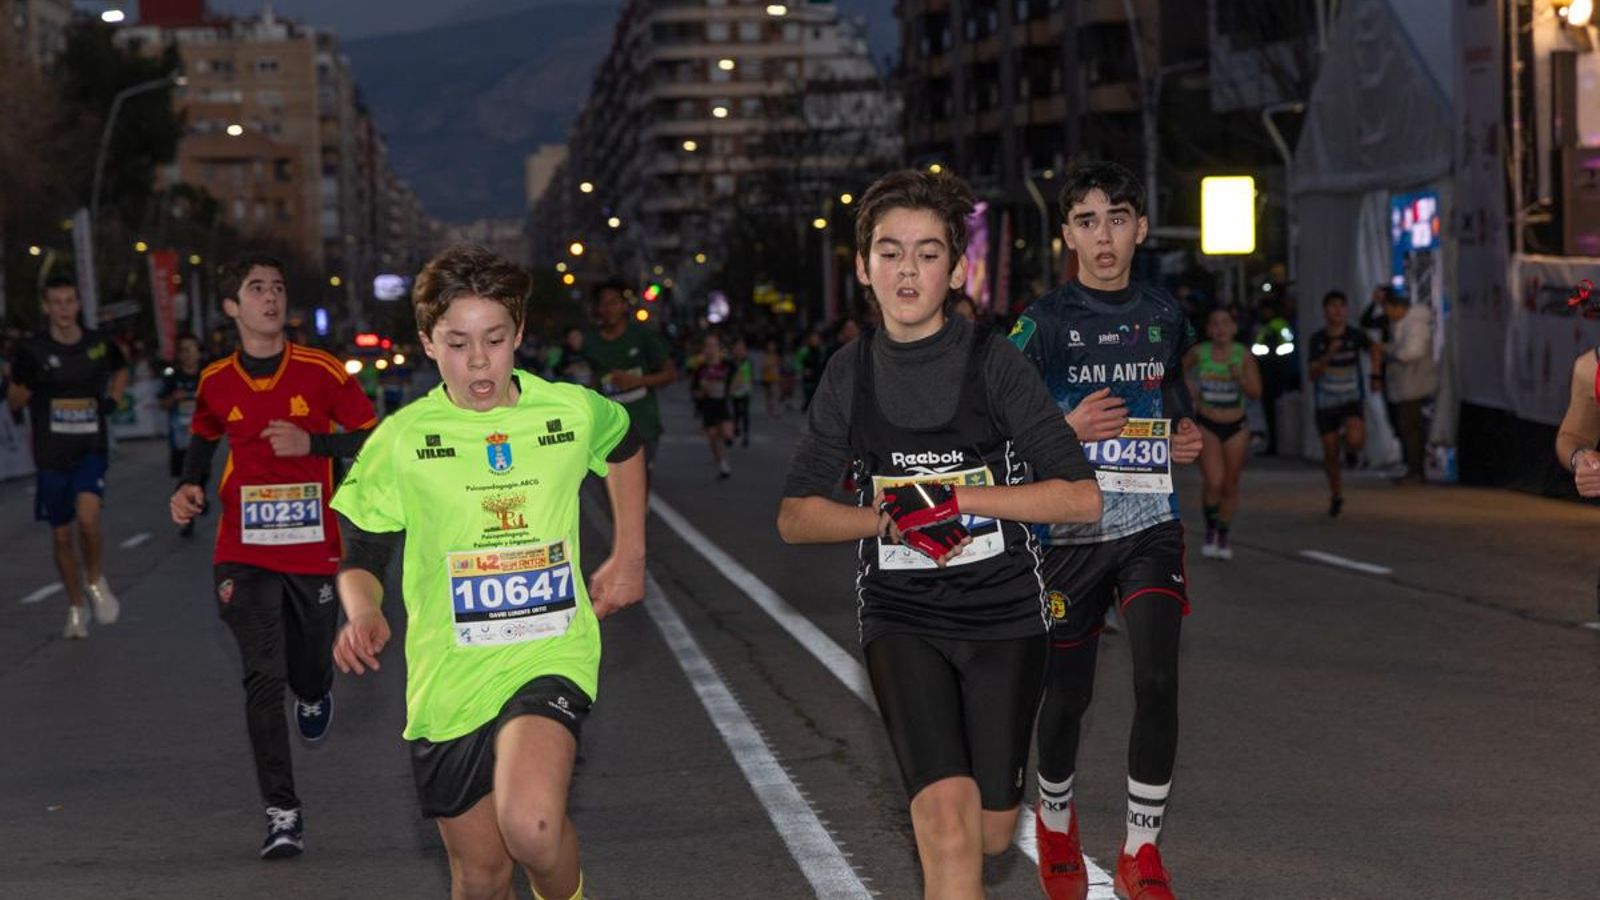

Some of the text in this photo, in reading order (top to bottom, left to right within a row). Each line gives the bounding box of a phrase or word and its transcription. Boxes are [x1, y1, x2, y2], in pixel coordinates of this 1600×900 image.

[1067, 357, 1165, 384] SAN ANTÓN
[538, 431, 575, 446] VILCO
[416, 447, 456, 460] VILCO
[891, 450, 964, 468] Reebok
[1084, 439, 1167, 464] 10430
[246, 500, 317, 523] 10231
[455, 566, 571, 610] 10647
